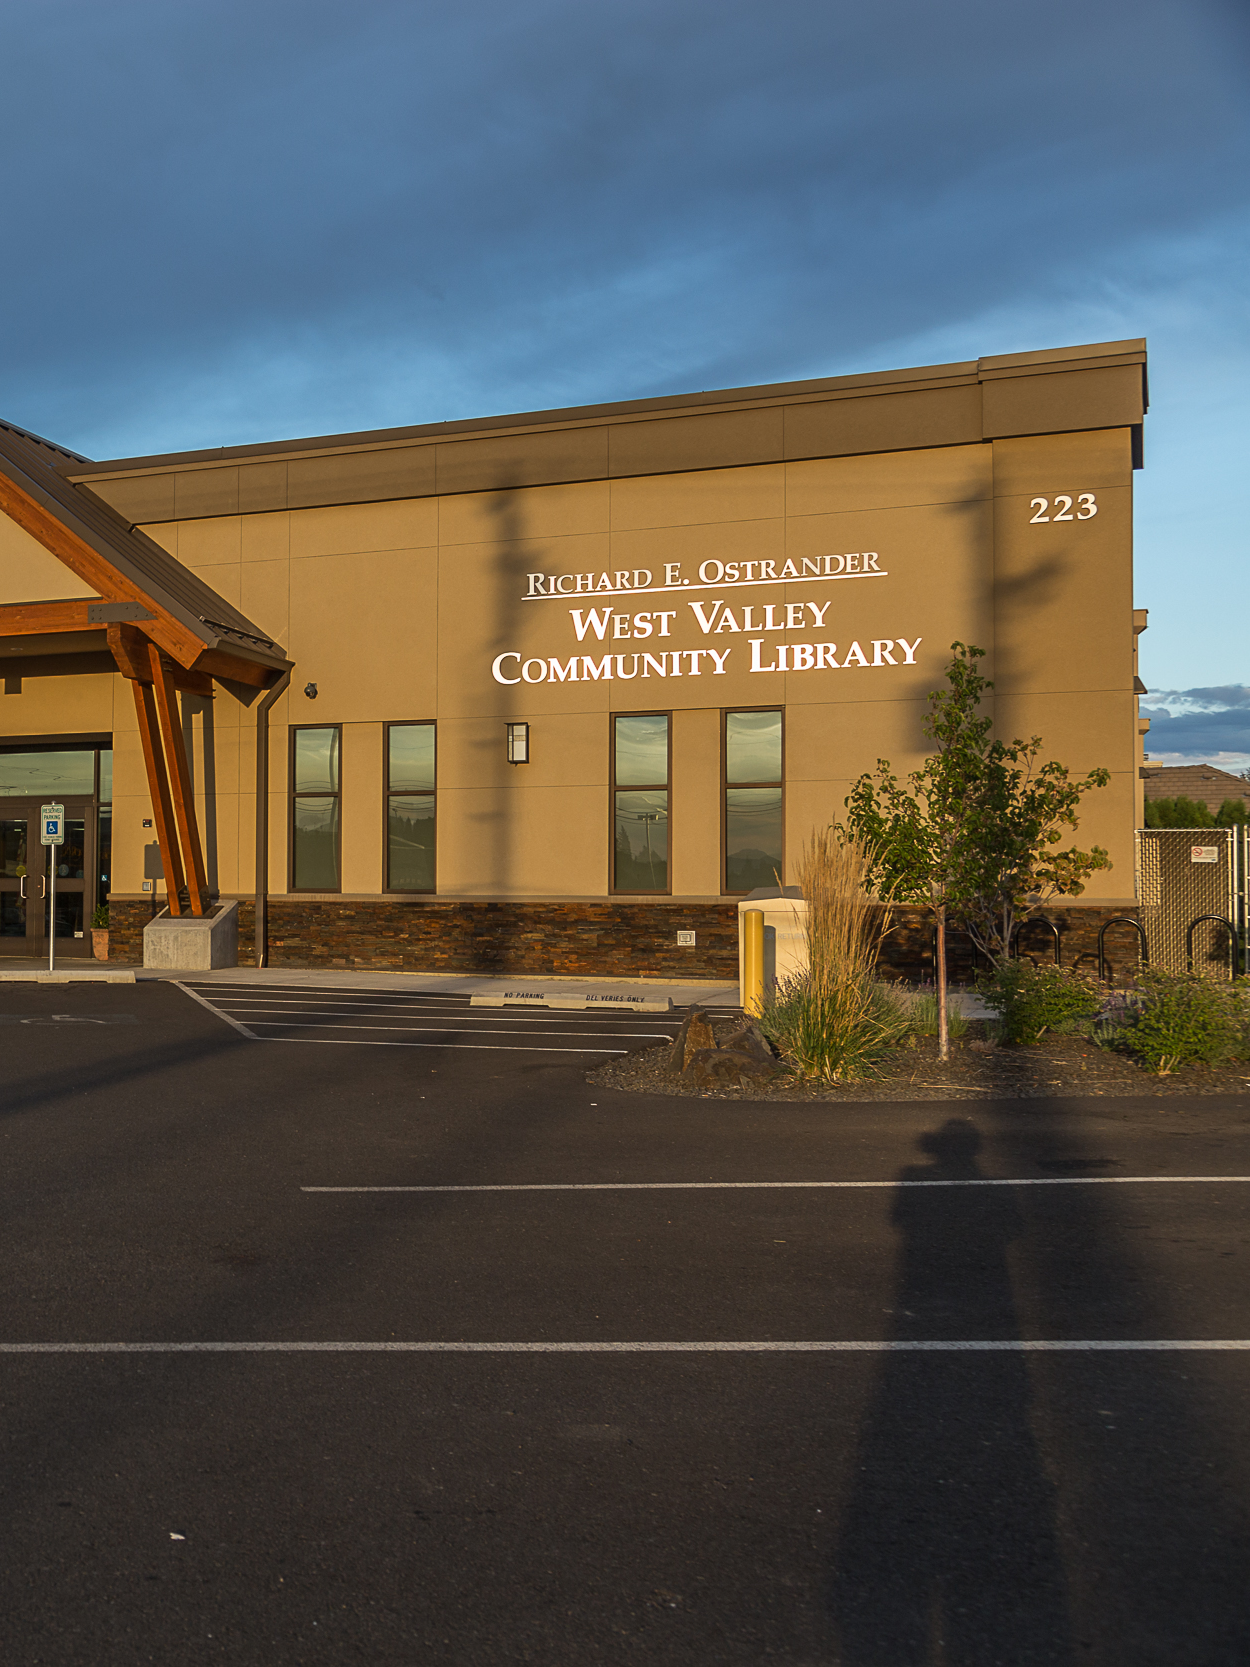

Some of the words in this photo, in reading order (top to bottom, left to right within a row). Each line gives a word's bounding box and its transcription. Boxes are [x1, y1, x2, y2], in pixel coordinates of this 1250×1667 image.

[1029, 493, 1098, 524] 223
[526, 569, 652, 596] RICHARD
[663, 562, 690, 586] E.
[698, 551, 881, 584] OSTRANDER
[568, 607, 677, 642] WEST
[687, 600, 832, 634] VALLEY
[491, 648, 732, 685] COMMUNITY
[747, 637, 923, 673] LIBRARY
